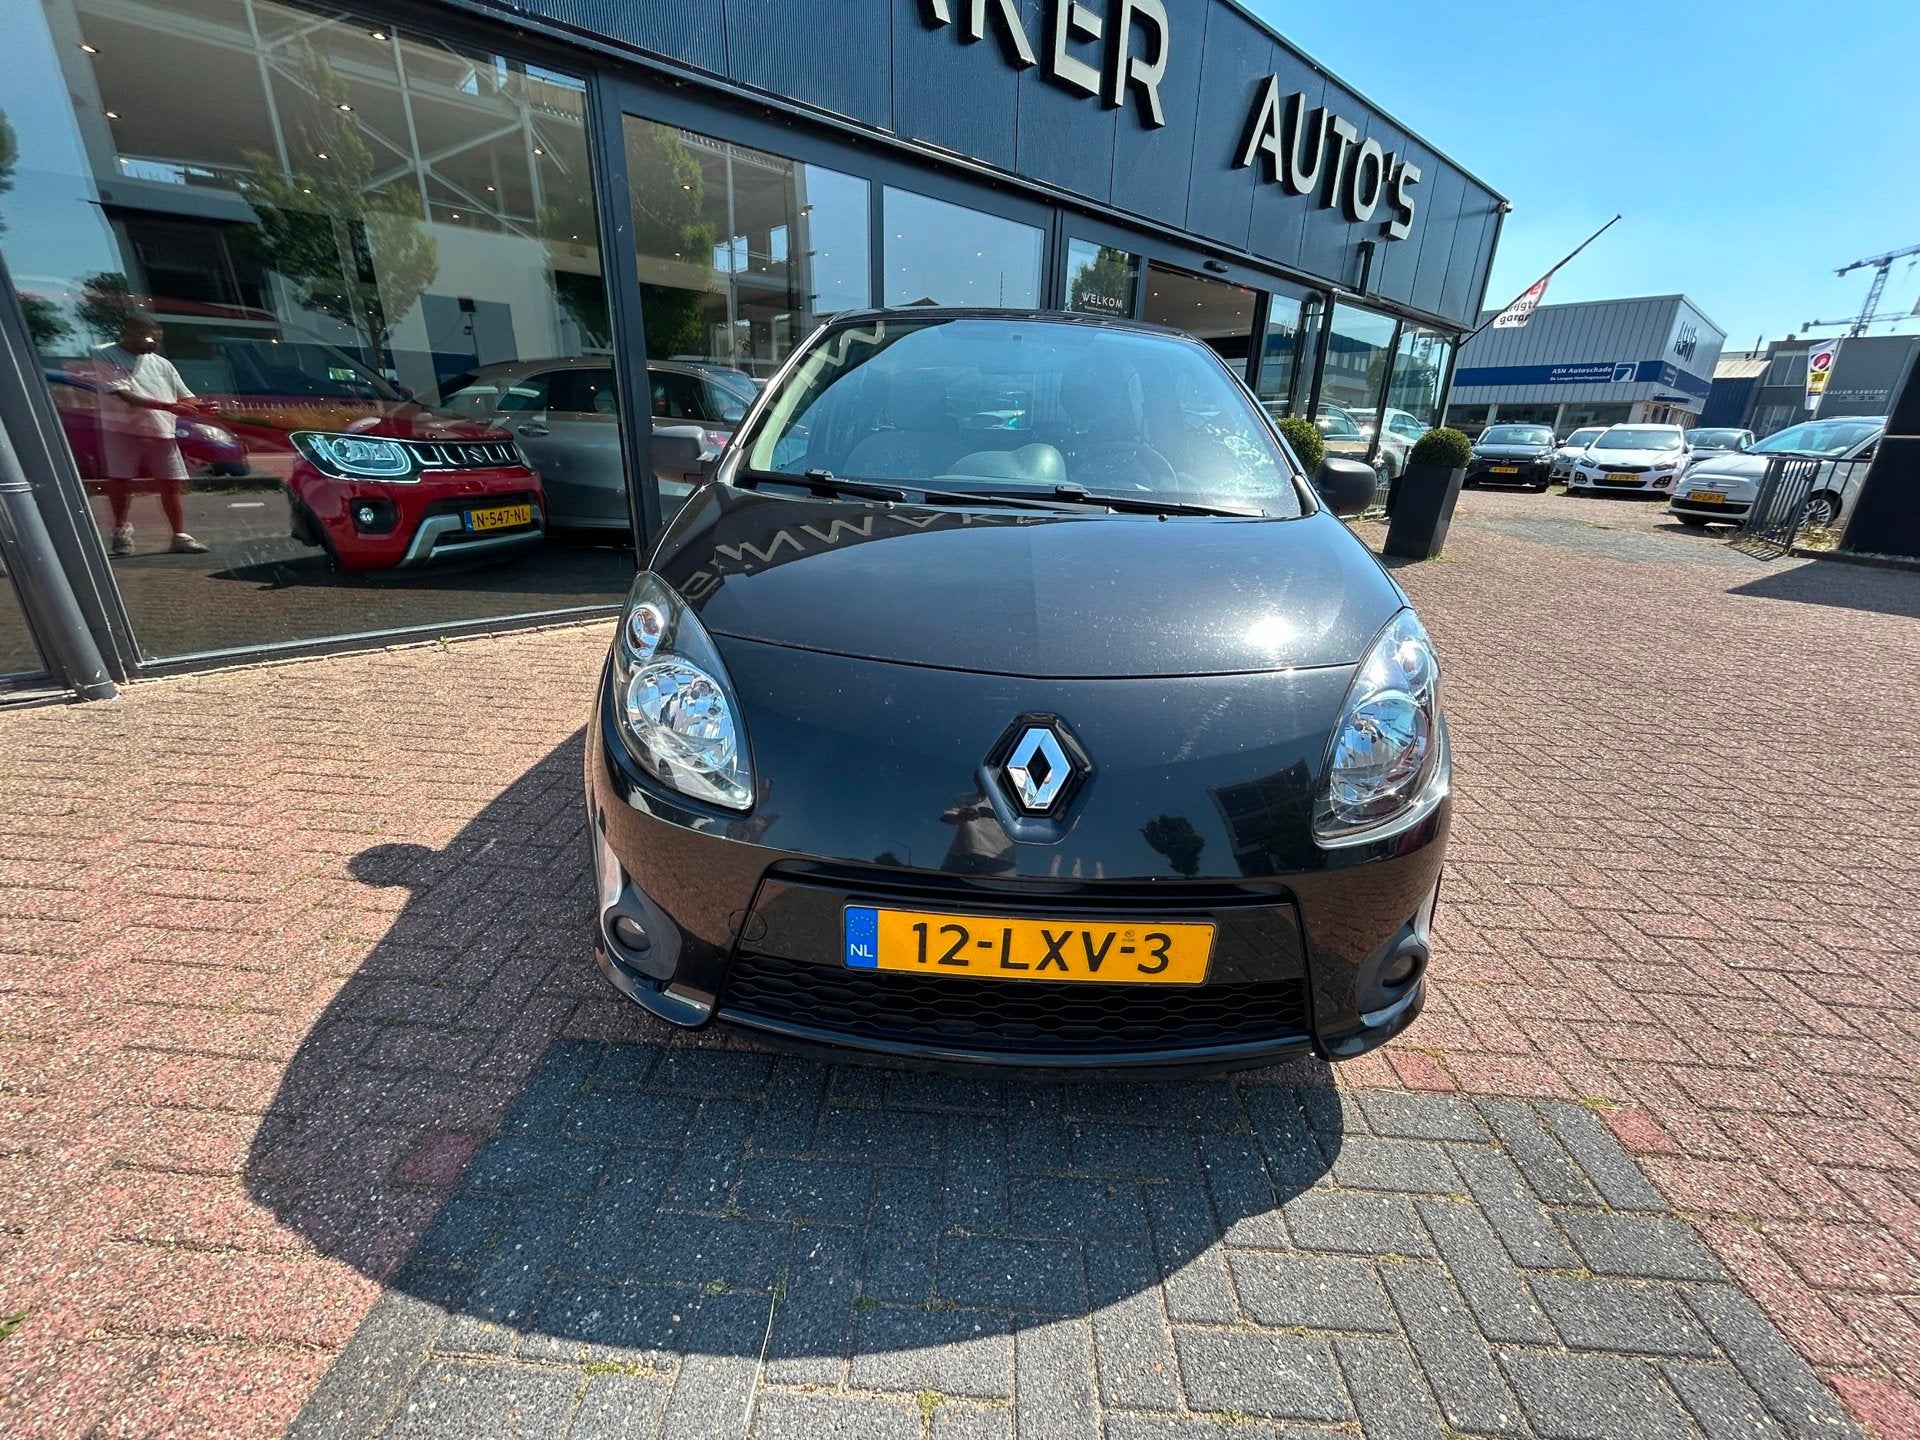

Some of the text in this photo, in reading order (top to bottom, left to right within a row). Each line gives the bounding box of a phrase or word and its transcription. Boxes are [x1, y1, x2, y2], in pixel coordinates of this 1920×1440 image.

[1241, 72, 1421, 241] AUTO'S
[1081, 291, 1123, 309] WELKOM
[1568, 366, 1613, 374] Autoschade
[476, 508, 527, 527] N-547-NL
[850, 943, 874, 958] NL
[912, 922, 1172, 975] 12-LXV-3
